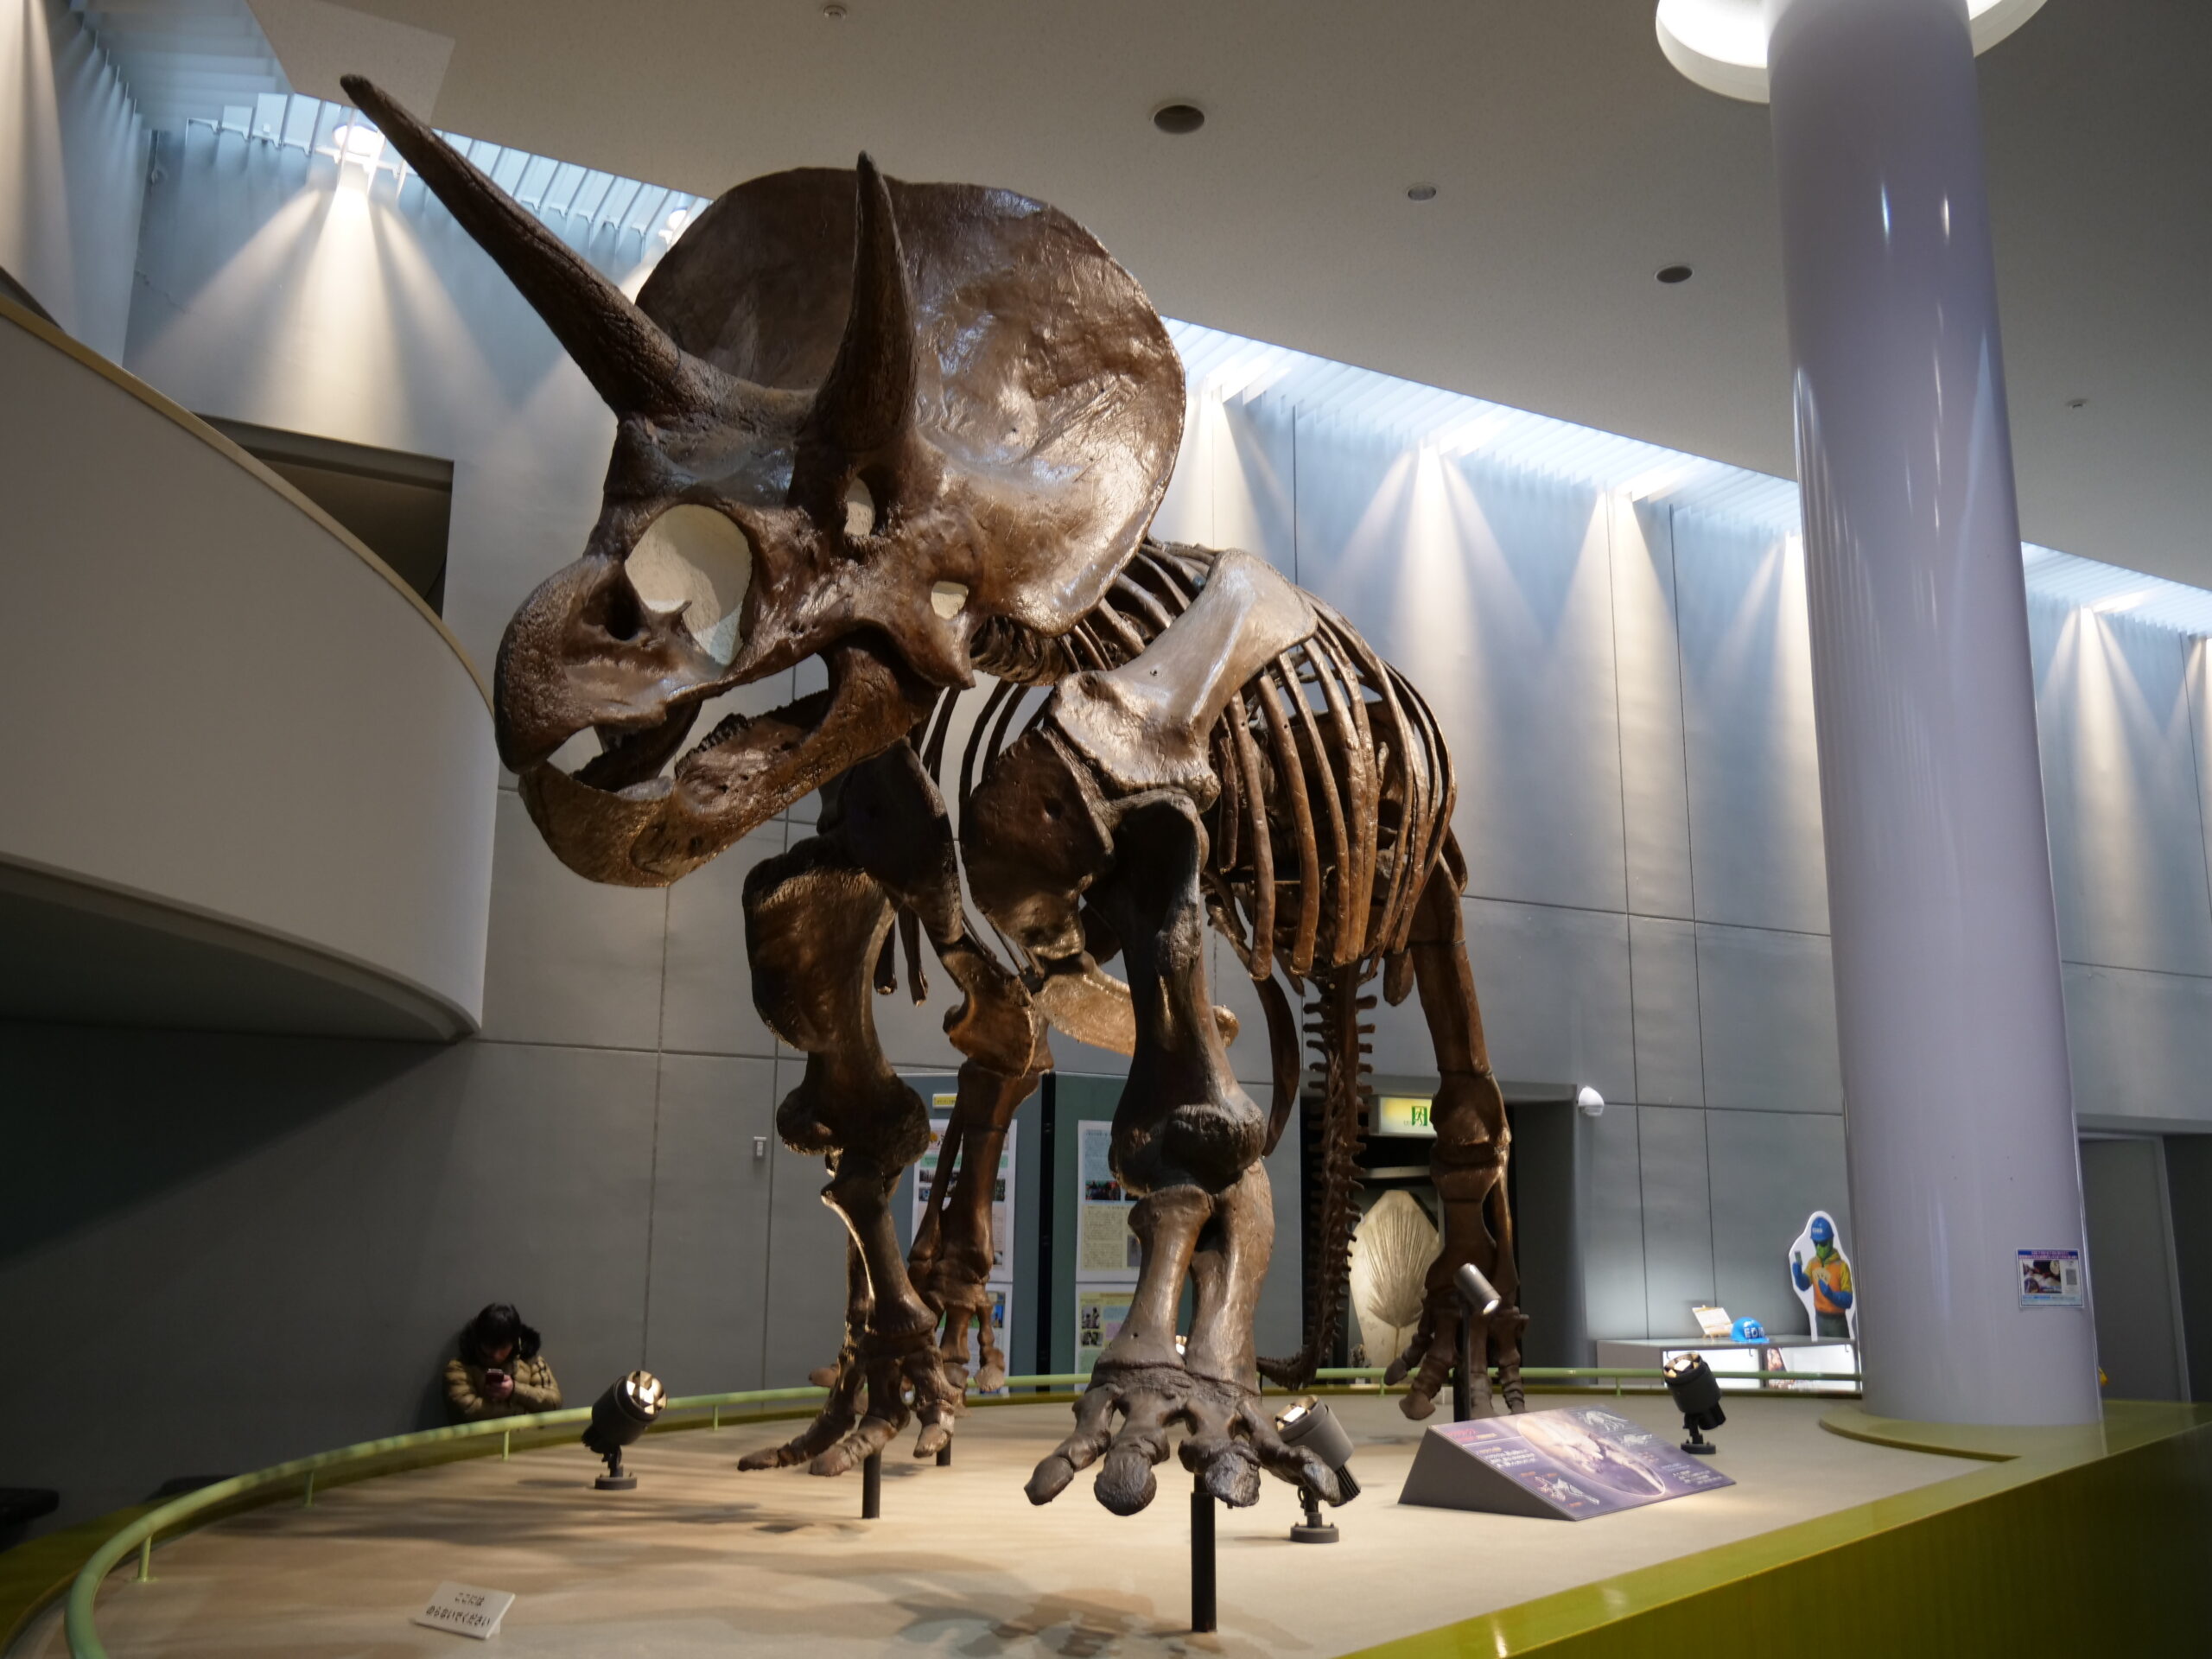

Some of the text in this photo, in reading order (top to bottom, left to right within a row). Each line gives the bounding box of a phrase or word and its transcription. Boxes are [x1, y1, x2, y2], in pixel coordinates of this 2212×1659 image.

[454, 1592, 485, 1606] ここには
[426, 1605, 491, 1626] のらないでください
